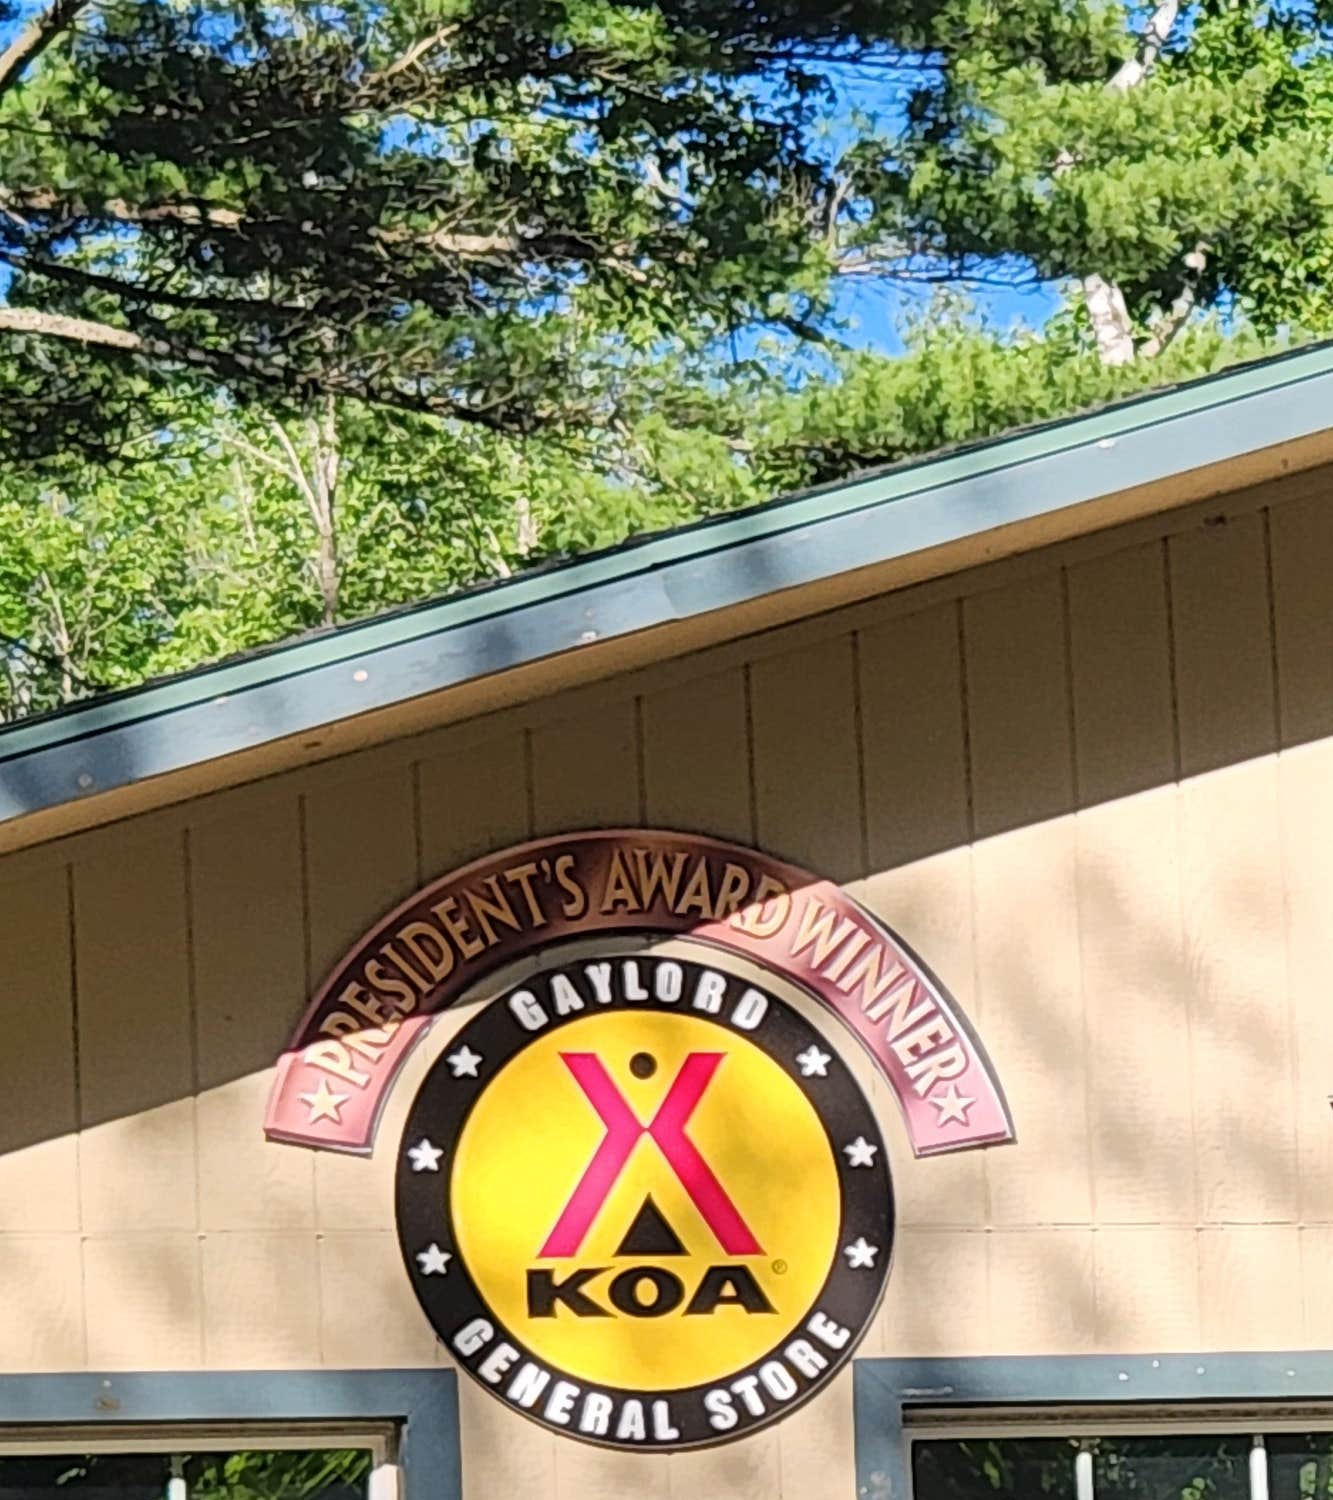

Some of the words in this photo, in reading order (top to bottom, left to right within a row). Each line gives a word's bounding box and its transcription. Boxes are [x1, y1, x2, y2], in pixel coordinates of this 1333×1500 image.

[304, 855, 587, 1086] PRESIDENT'S
[601, 848, 793, 939] AWARD
[789, 899, 968, 1097] WINNER
[508, 960, 769, 1031] GAYLORD
[525, 1264, 780, 1319] KOA
[452, 1317, 680, 1441] GENERAL
[704, 1311, 852, 1431] STORE
